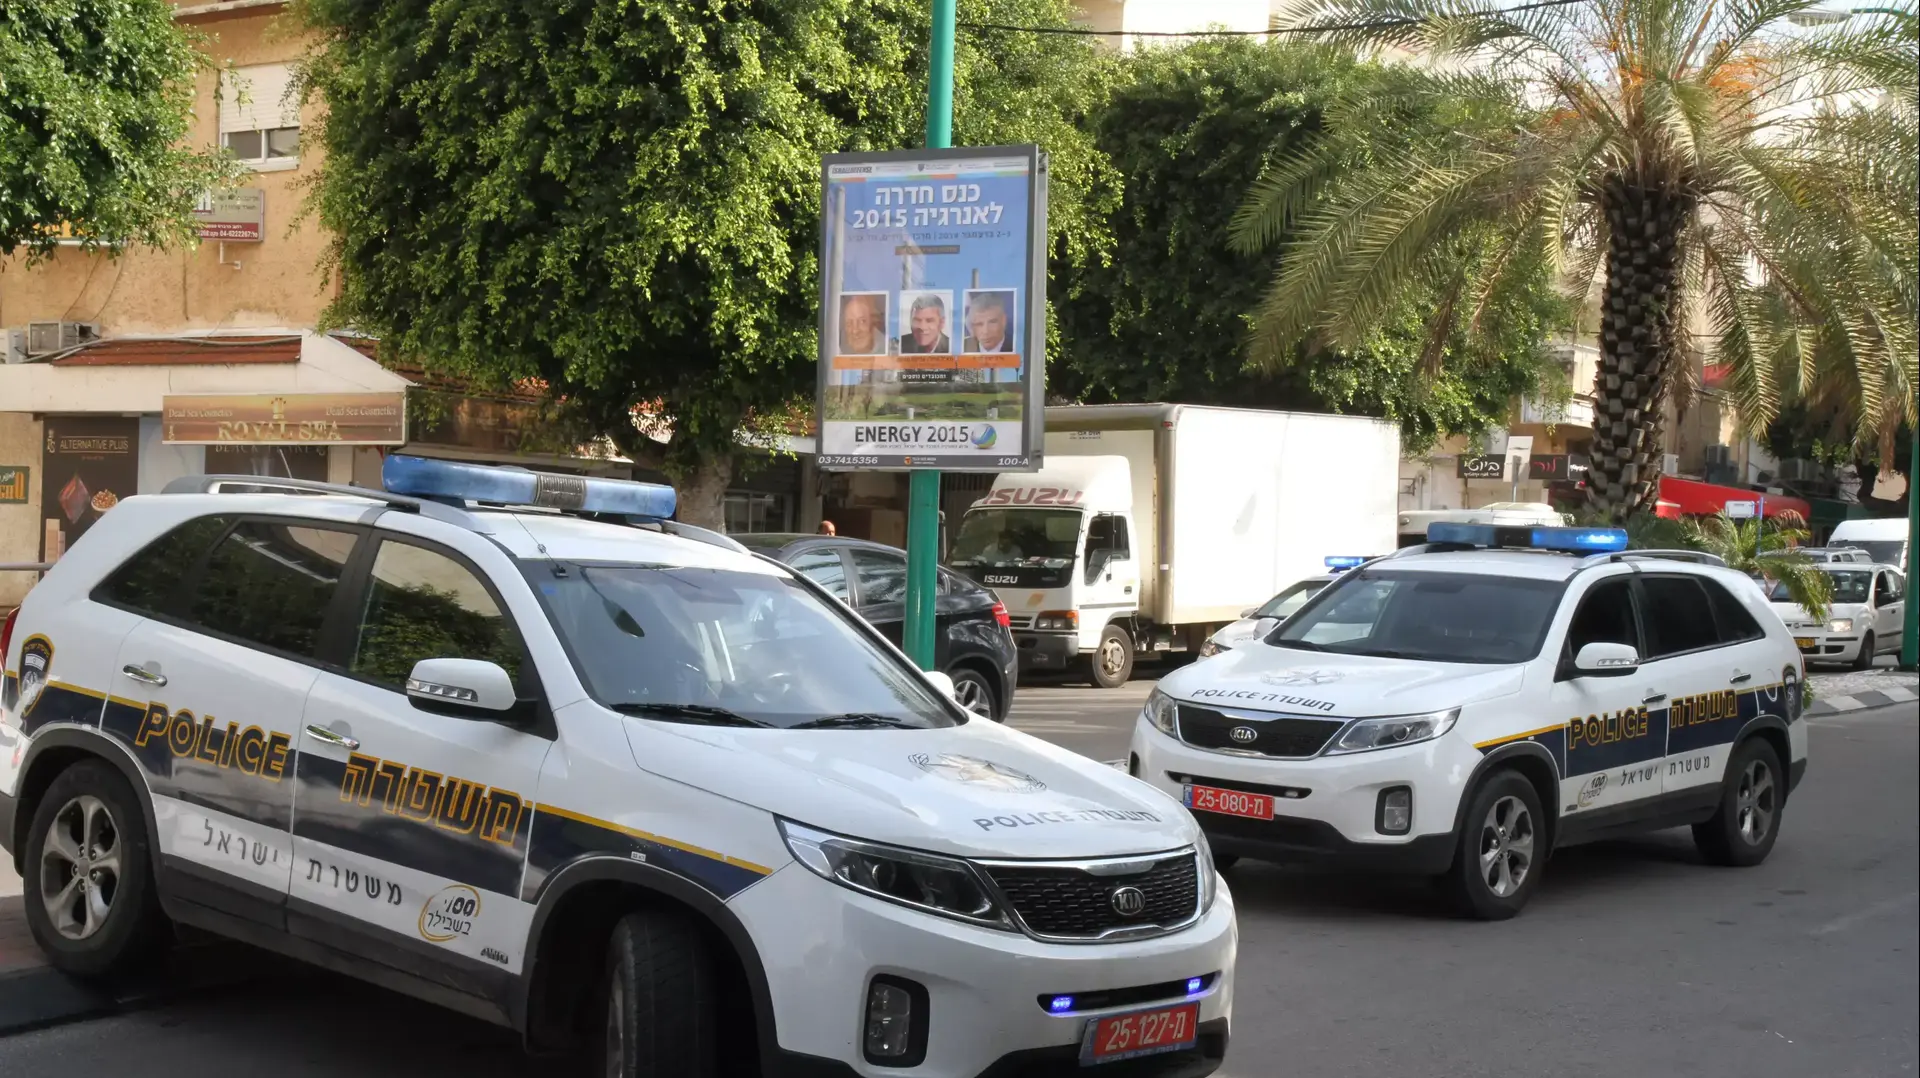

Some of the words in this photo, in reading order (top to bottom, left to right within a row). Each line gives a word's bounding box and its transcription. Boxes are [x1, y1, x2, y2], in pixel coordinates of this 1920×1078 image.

[875, 186, 934, 206] חדרה
[942, 184, 981, 203] כנס
[852, 210, 907, 230] 2015
[913, 202, 1004, 227] לאנרגיה
[168, 408, 186, 418] Dead
[187, 409, 199, 418] Sea
[199, 408, 234, 418] Cosmetics
[325, 406, 344, 416] Dead
[345, 407, 359, 416] Sea
[360, 405, 397, 416] Cosmetics
[217, 420, 288, 441] ROYAL
[298, 420, 342, 441] SEA
[855, 426, 922, 442] ENERGY
[927, 425, 968, 443] 2015
[60, 439, 108, 450] ALTERNATIVE
[108, 439, 129, 451] PLUS
[818, 456, 878, 465] 03-7415356
[997, 457, 1029, 466] 100-A
[983, 487, 1084, 505] ISUZU
[983, 574, 1018, 584] ISUZU
[1191, 689, 1261, 699] POLICE
[1261, 693, 1336, 711] משטרה
[1670, 689, 1738, 729] משטרה
[1232, 729, 1252, 741] KIA
[1568, 706, 1648, 750] POLICE
[134, 700, 292, 783] POLICE
[1620, 765, 1659, 787] ישראל
[1669, 756, 1711, 776] משטרת
[339, 751, 525, 847] משטרה
[1197, 788, 1264, 816] 25-080-מ
[973, 811, 1070, 832] POLICE
[1071, 810, 1162, 823] משטרה
[203, 818, 280, 867] ישראל
[305, 857, 403, 906] משטרת
[1115, 893, 1143, 910] KIA
[427, 910, 472, 936] בשבילך
[1104, 1011, 1187, 1052] 25-127-מ
